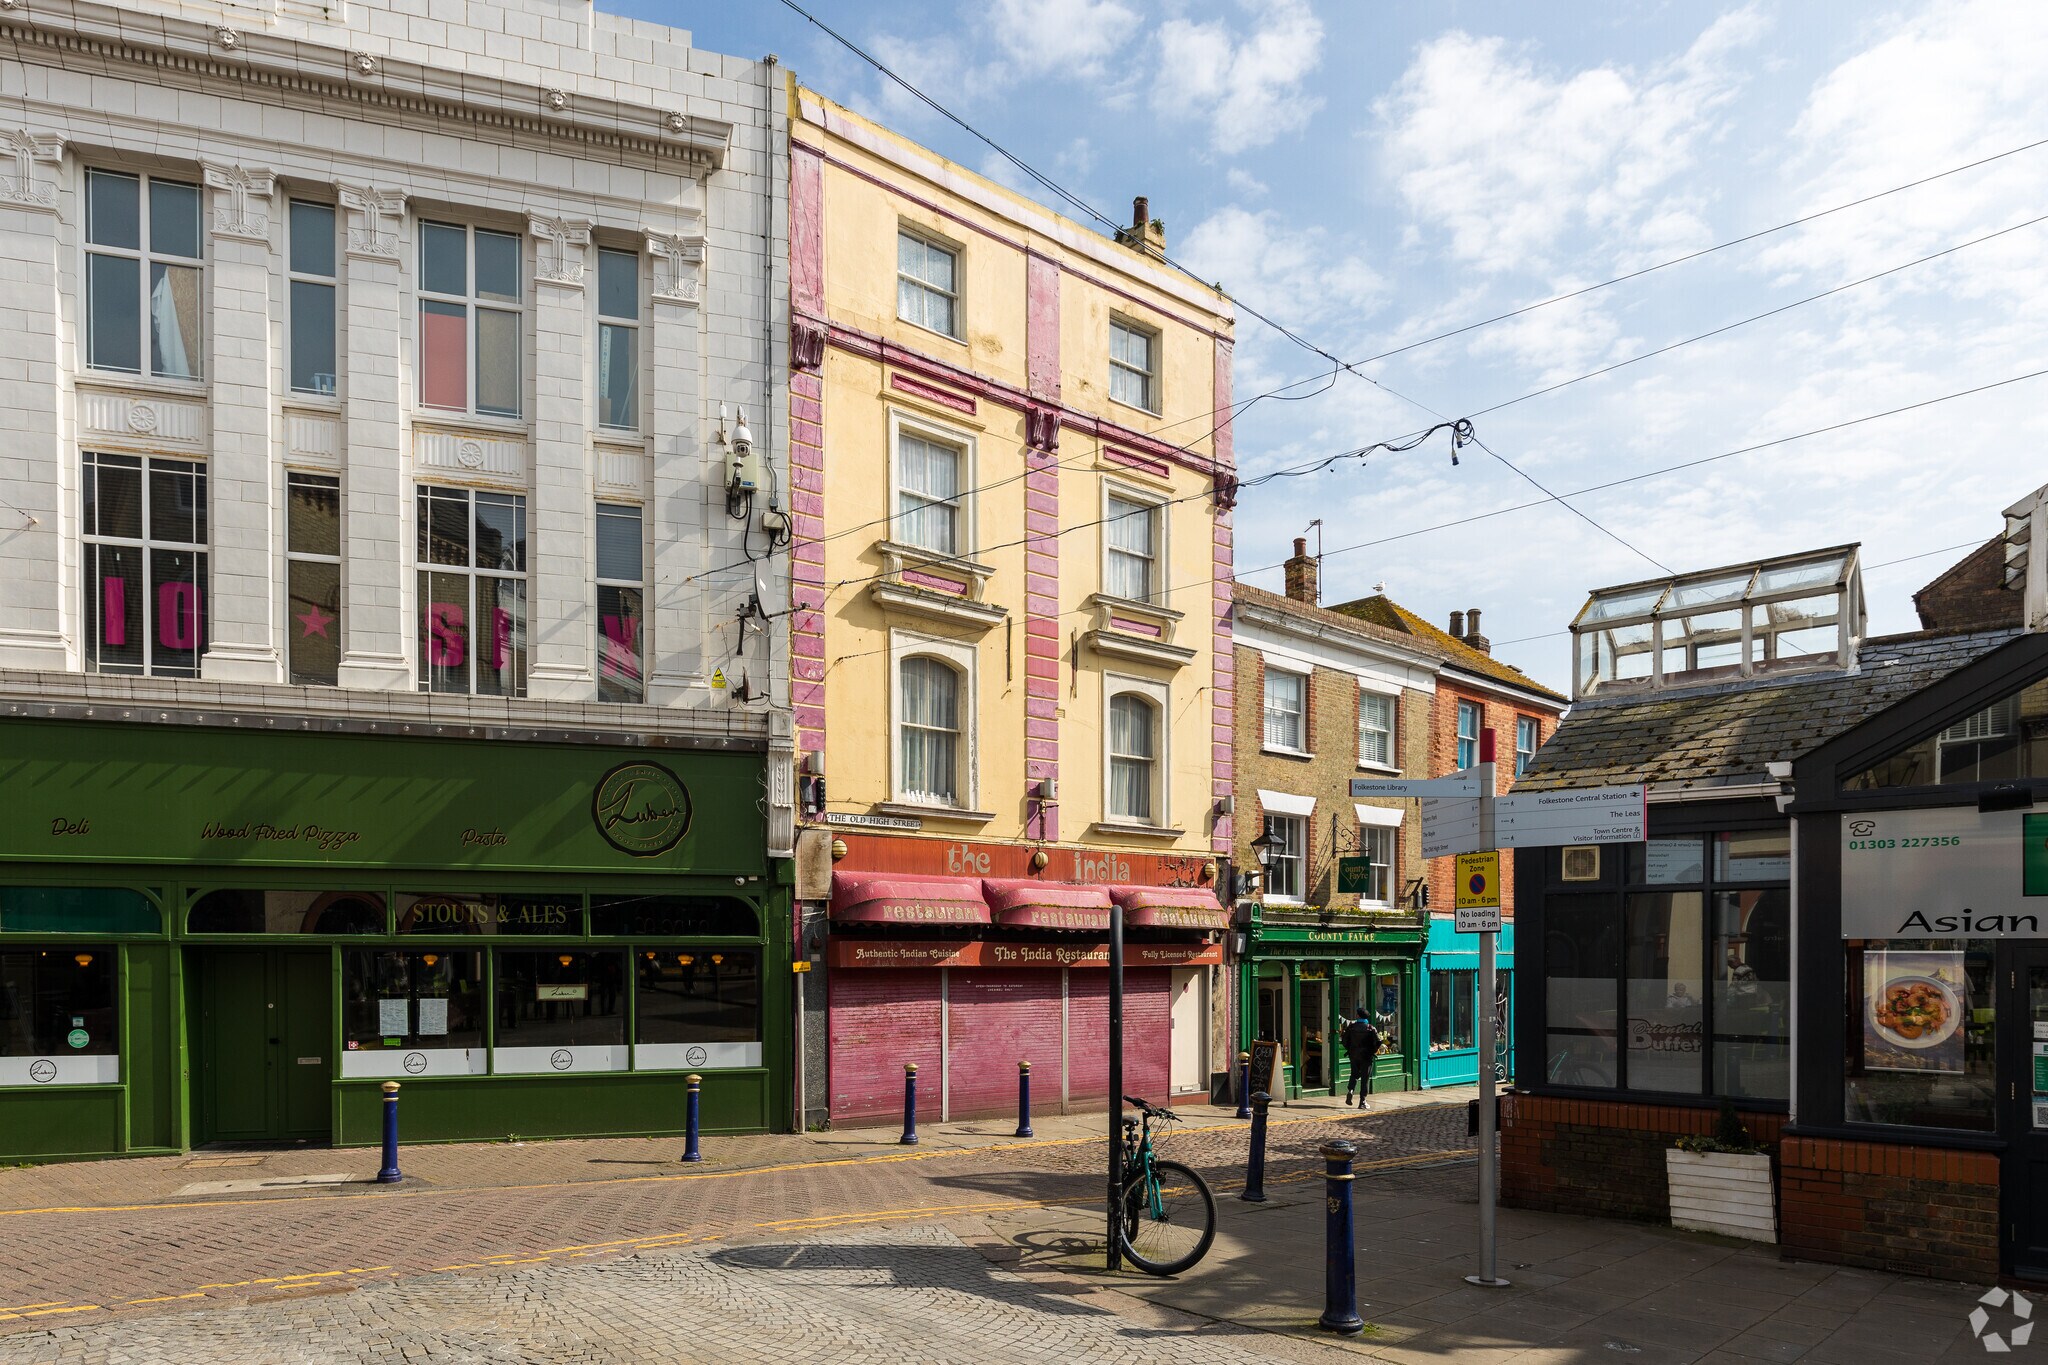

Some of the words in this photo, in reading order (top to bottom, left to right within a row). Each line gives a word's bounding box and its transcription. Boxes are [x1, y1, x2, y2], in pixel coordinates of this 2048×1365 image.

[1387, 784, 1408, 792] Library
[52, 818, 90, 836] Deli
[830, 814, 846, 822] THE
[850, 816, 866, 824] OLD
[869, 817, 890, 826] HIGH
[892, 819, 920, 828] STREET
[202, 822, 251, 840] Wood
[253, 822, 299, 841] Fired
[302, 825, 360, 850] Pizza
[460, 827, 508, 847] Pasta
[1849, 839, 1896, 850] 01303
[1901, 836, 1960, 848] 227356
[948, 844, 990, 874] the
[1074, 852, 1130, 882] india
[1461, 856, 1494, 864] Pedestrian
[412, 904, 488, 924] STOUTS
[496, 904, 510, 923] &
[518, 905, 566, 924] ALES
[883, 904, 981, 920] restaurant
[1153, 911, 1224, 928] restaurant
[1897, 908, 2038, 934] Asian
[1308, 932, 1343, 941] COUNTY
[1348, 932, 1375, 941] FAYRE
[856, 949, 898, 960] Authentic
[900, 949, 927, 958] Indian
[930, 949, 960, 958] Cuisine
[994, 946, 1017, 961] The
[1020, 948, 1052, 961] India
[1056, 948, 1110, 964] Restauran
[1142, 950, 1158, 959] Fully
[1160, 950, 1186, 958] Licensed
[1188, 951, 1218, 960] Restaurant
[1270, 947, 1281, 955] The
[1627, 1018, 1702, 1052] Buffet
